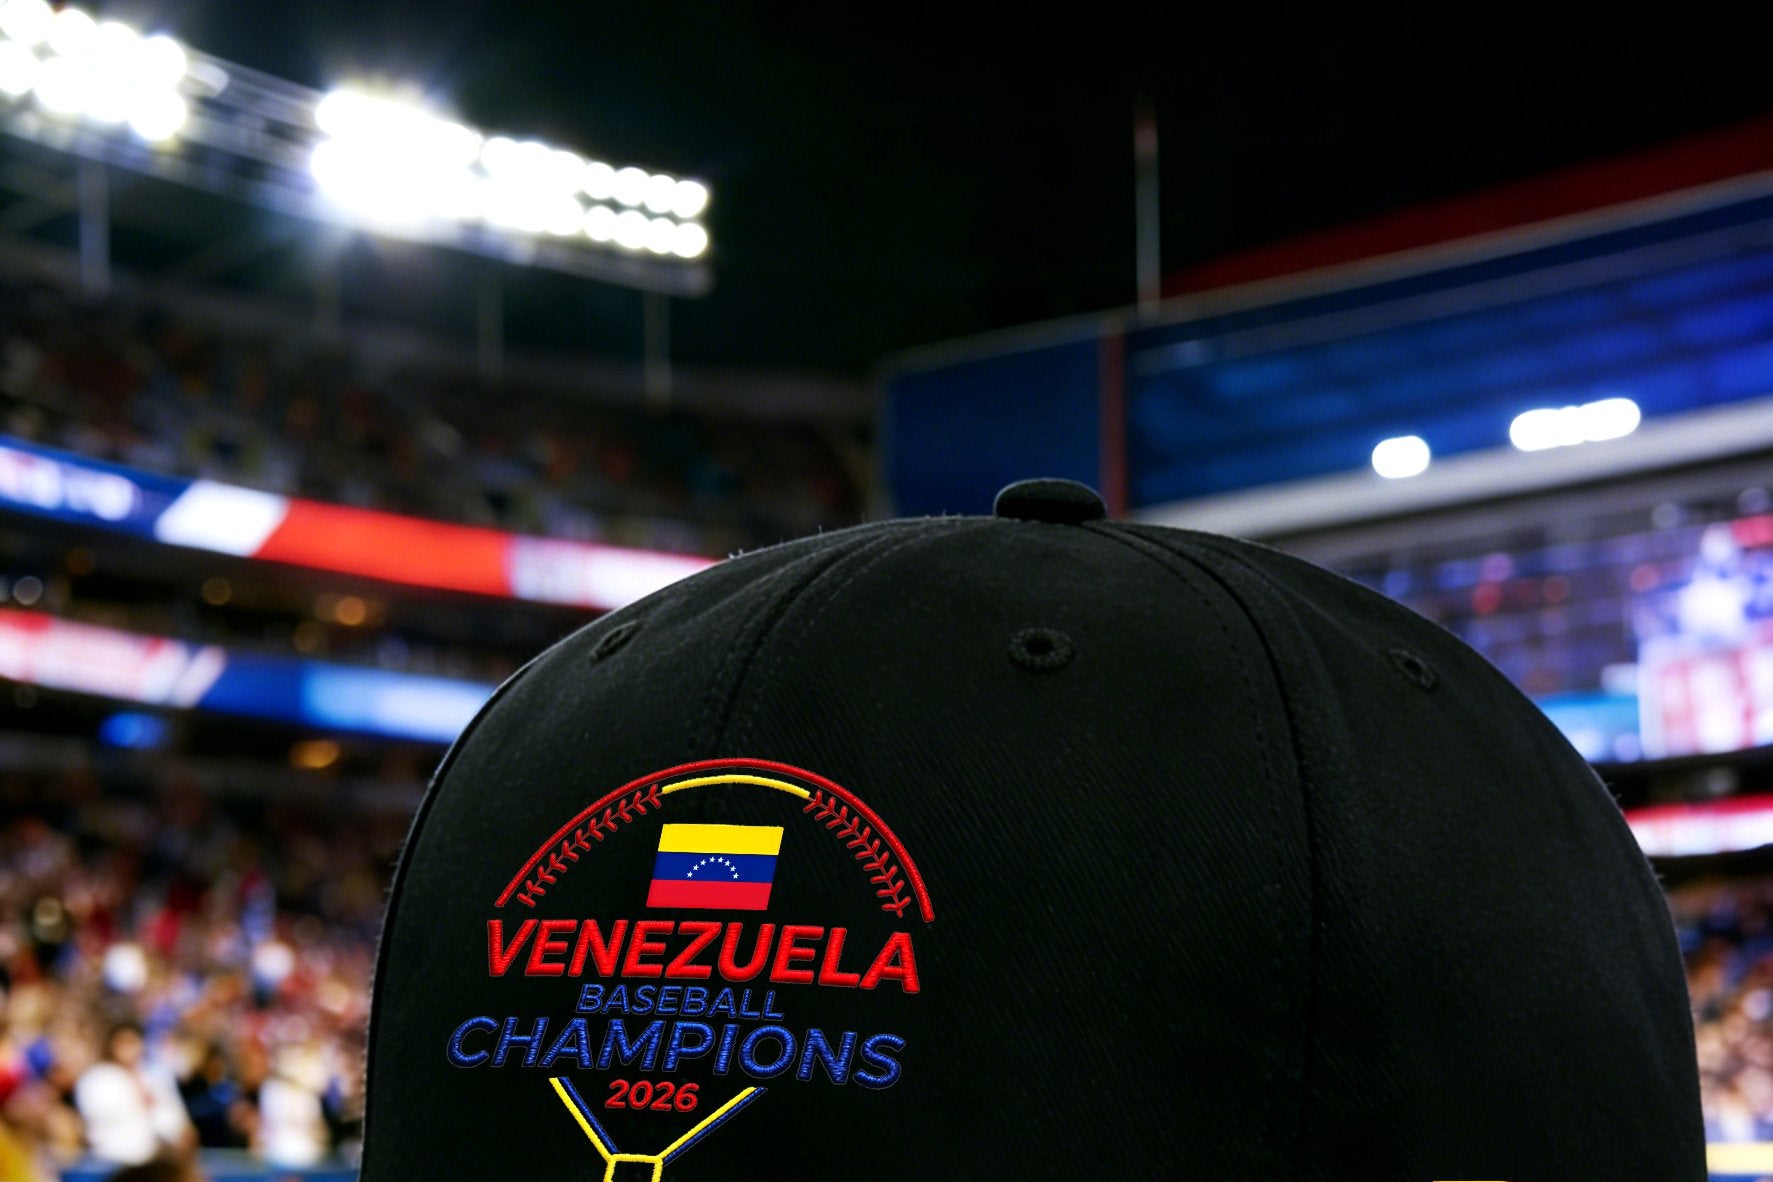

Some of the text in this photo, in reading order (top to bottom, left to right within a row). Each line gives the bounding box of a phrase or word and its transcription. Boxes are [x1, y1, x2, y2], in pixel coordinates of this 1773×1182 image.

[487, 919, 920, 994] VENEZUELA
[576, 983, 785, 1021] BASEBALL
[447, 1016, 906, 1090] CHAMPIONS
[605, 1079, 700, 1112] 2026
